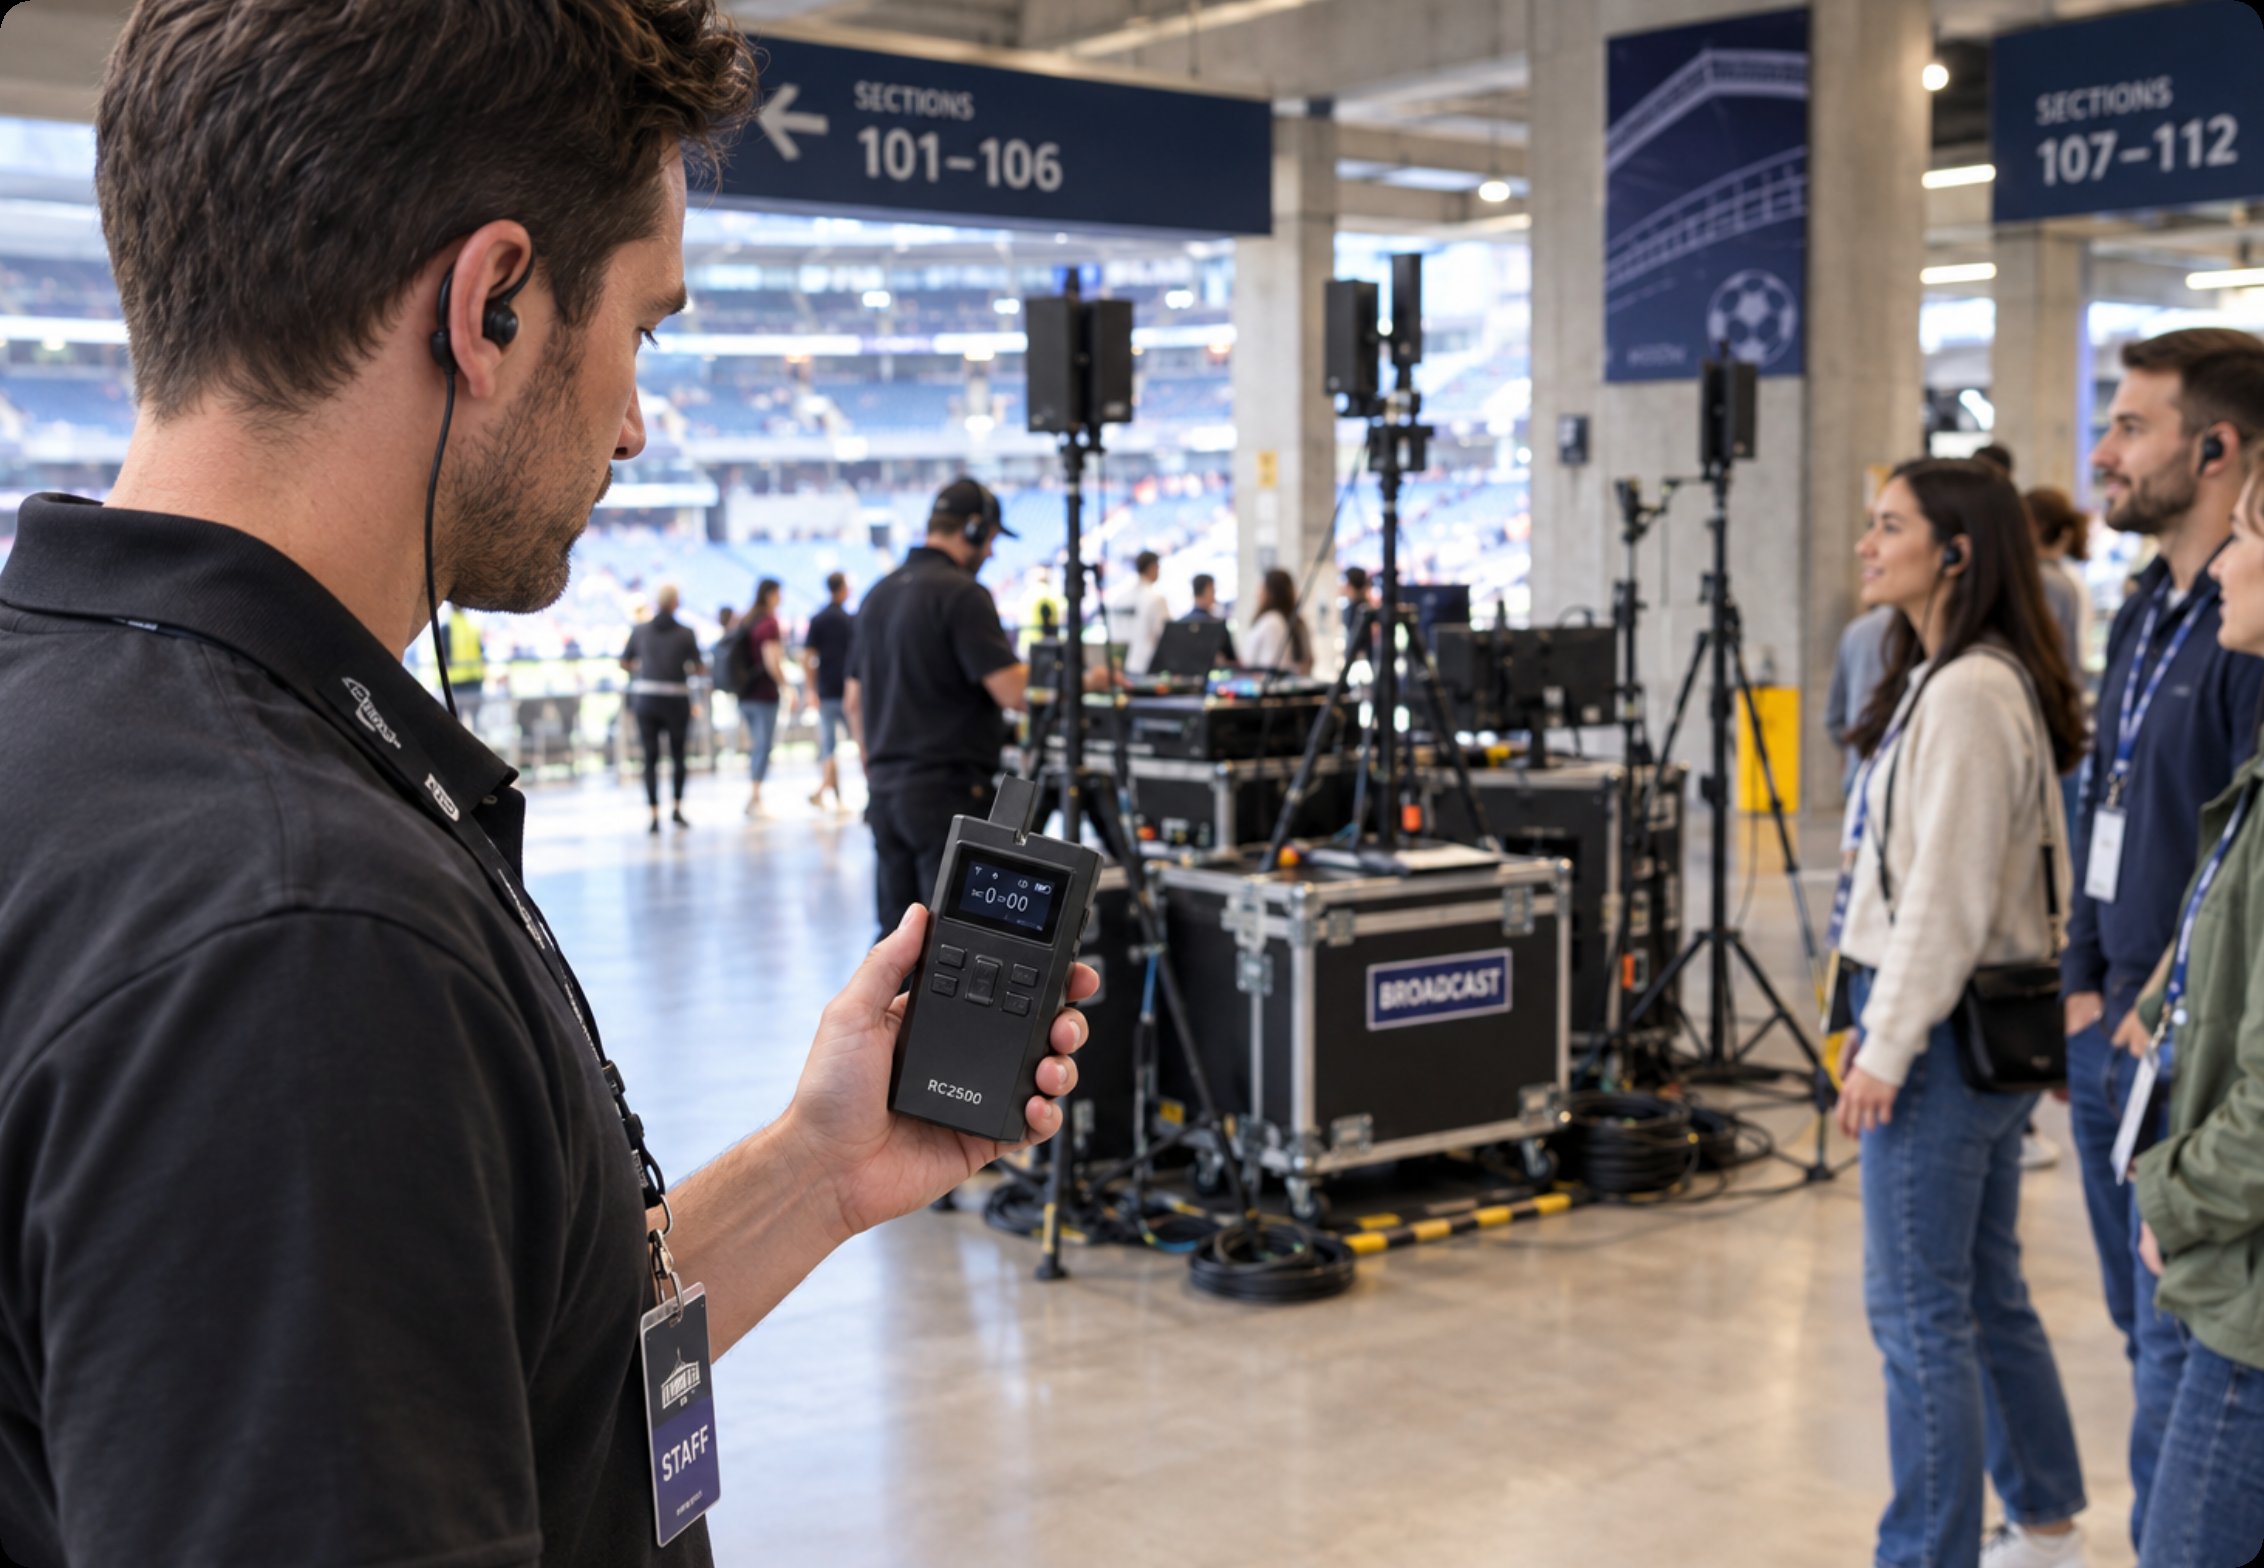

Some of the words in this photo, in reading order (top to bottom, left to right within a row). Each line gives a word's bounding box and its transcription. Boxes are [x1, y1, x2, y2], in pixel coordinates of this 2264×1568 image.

[854, 81, 974, 120] SECTIONS
[2035, 75, 2172, 125] SECTIONS
[1378, 967, 1501, 1011] BROADCAST
[927, 1079, 983, 1105] RC2500
[661, 1424, 709, 1482] STAFF
